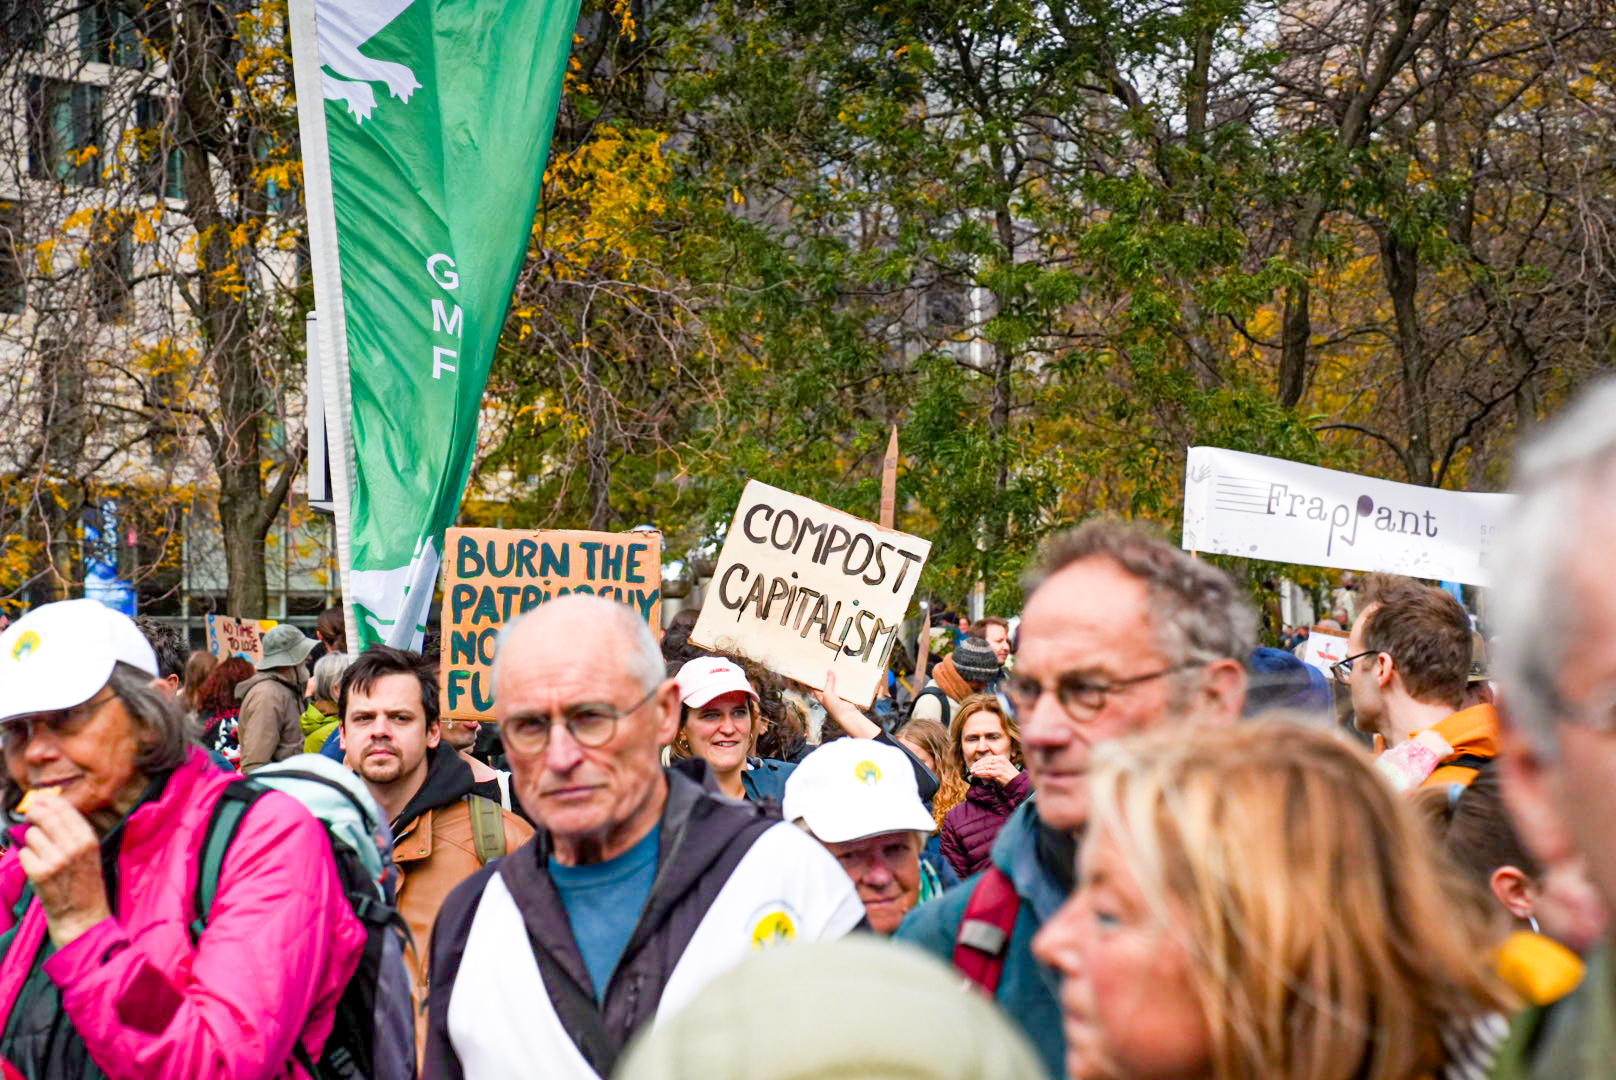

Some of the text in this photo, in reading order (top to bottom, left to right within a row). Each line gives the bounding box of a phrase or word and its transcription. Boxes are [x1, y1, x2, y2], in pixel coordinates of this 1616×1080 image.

[1266, 482, 1438, 557] Frappant
[457, 535, 648, 583] BURN THE
[743, 503, 922, 594] COMPOST
[222, 623, 233, 635] NO
[227, 637, 240, 651] TO
